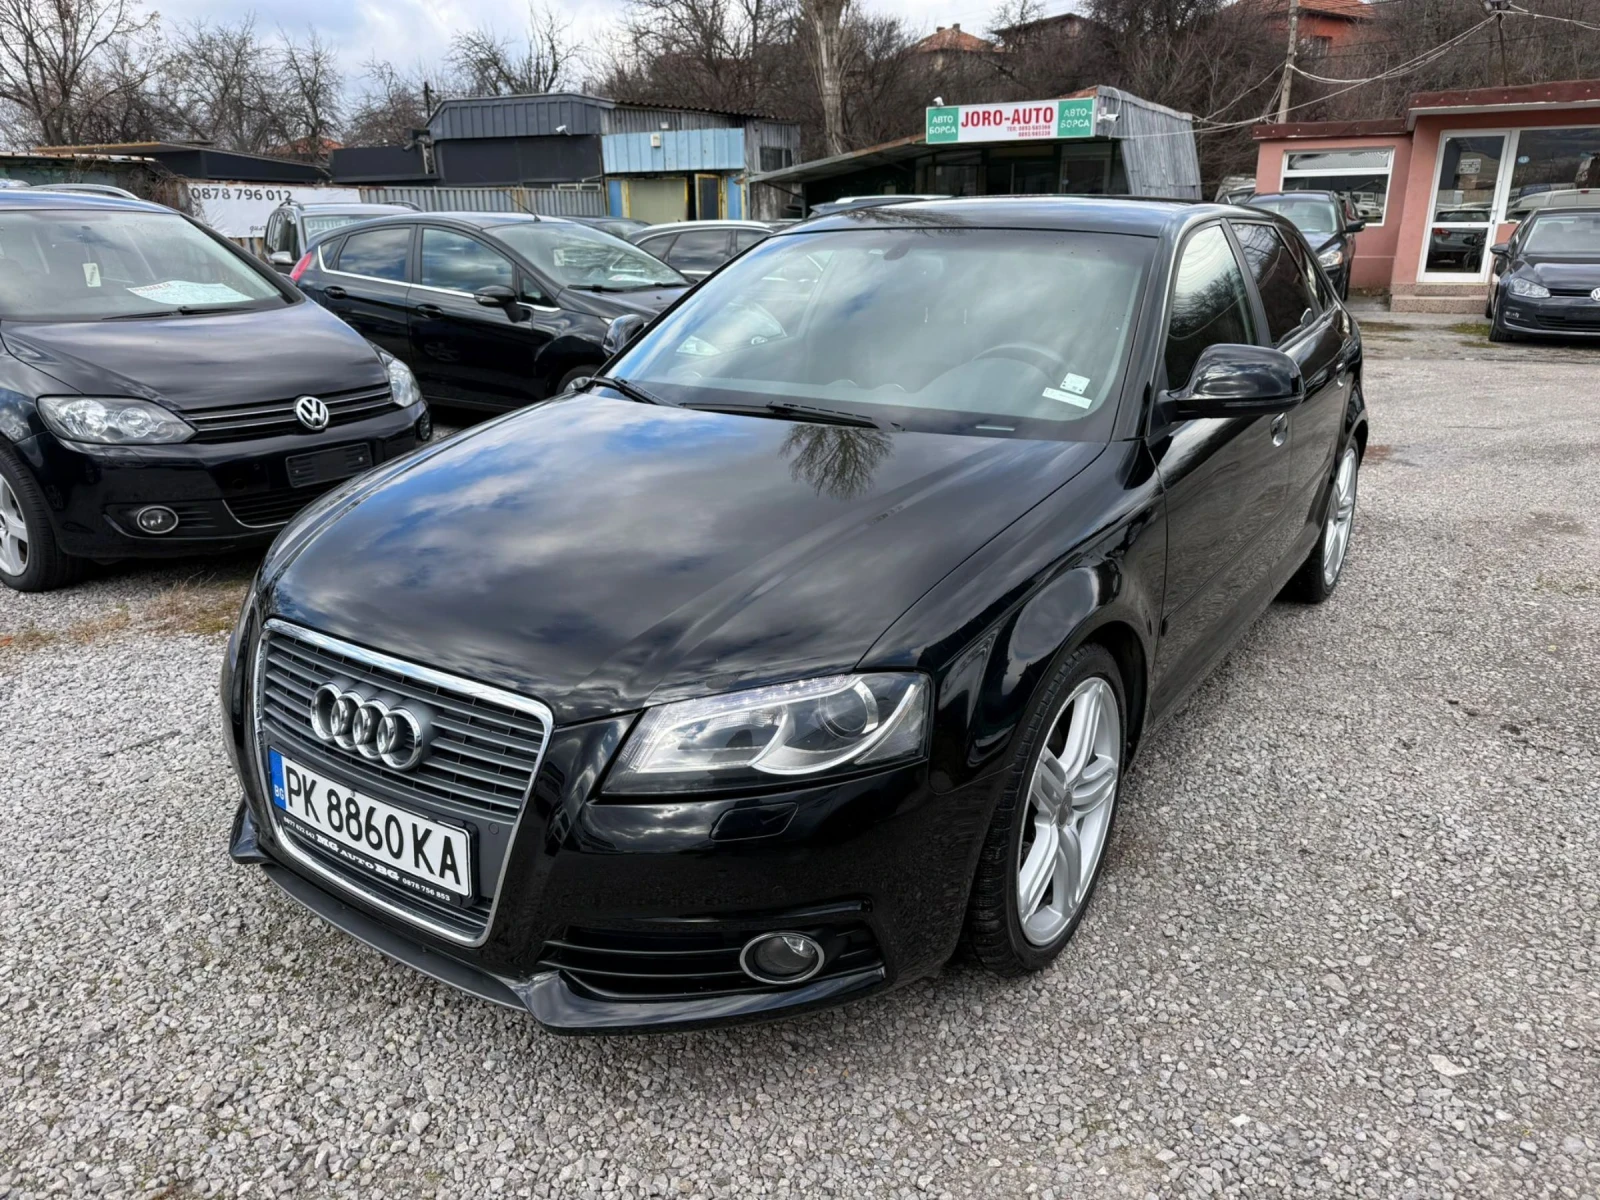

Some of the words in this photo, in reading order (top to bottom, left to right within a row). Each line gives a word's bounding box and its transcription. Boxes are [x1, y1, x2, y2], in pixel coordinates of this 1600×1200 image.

[932, 115, 954, 124] АВТО
[961, 106, 1054, 128] JORO-AUTO
[1060, 119, 1090, 129] БОРСА
[929, 125, 957, 135] БОРСА
[191, 187, 231, 200] 0878
[234, 188, 263, 201] 796
[266, 189, 292, 201] 012
[274, 784, 285, 801] BG
[285, 765, 321, 824] PK
[326, 788, 404, 860] 8860
[411, 822, 462, 886] KA
[315, 833, 340, 853] MG
